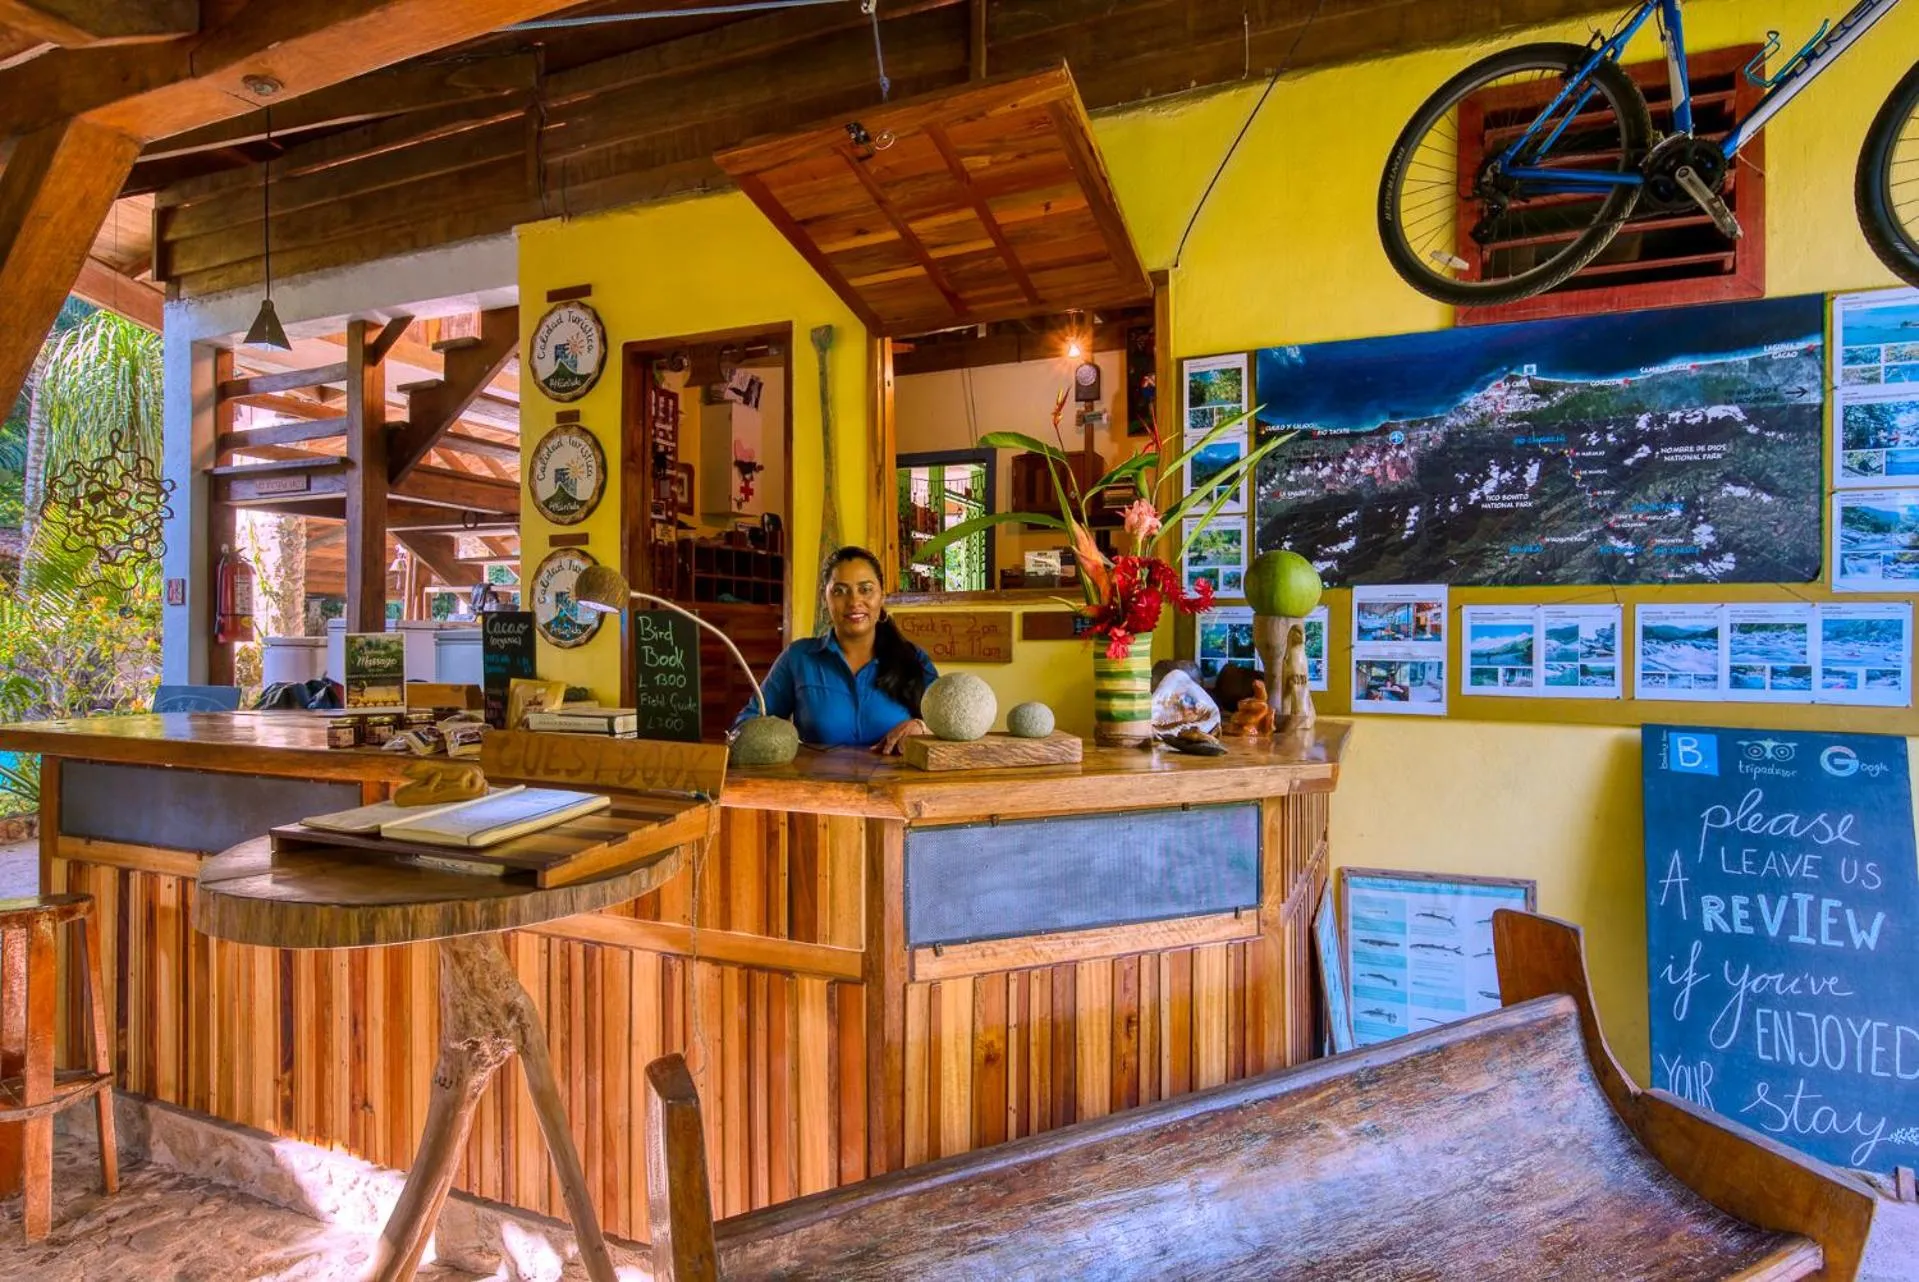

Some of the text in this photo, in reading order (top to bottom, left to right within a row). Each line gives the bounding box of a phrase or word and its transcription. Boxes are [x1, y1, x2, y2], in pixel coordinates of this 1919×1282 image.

[537, 312, 564, 360] Calidad
[537, 436, 564, 482] Calidad
[1660, 445, 1695, 454] NOMBRE
[1707, 443, 1727, 451] DIOS
[1663, 452, 1723, 462] NATIONAL PARK
[537, 561, 565, 604] Calidad
[486, 612, 529, 634] Cacao
[638, 616, 674, 647] Bird
[901, 616, 937, 637] Check
[940, 619, 953, 636] in
[641, 645, 685, 671] Book
[640, 692, 666, 707] Field
[654, 673, 687, 688] 1300
[1819, 744, 1890, 778] Google
[1698, 787, 1861, 863] please
[1720, 845, 1882, 890] LEAVE US
[1658, 849, 1886, 952] A REVIEW
[1659, 939, 1854, 1050] if you've
[1756, 1007, 1919, 1081] ENJOYED
[1658, 1053, 1716, 1113] YOUR
